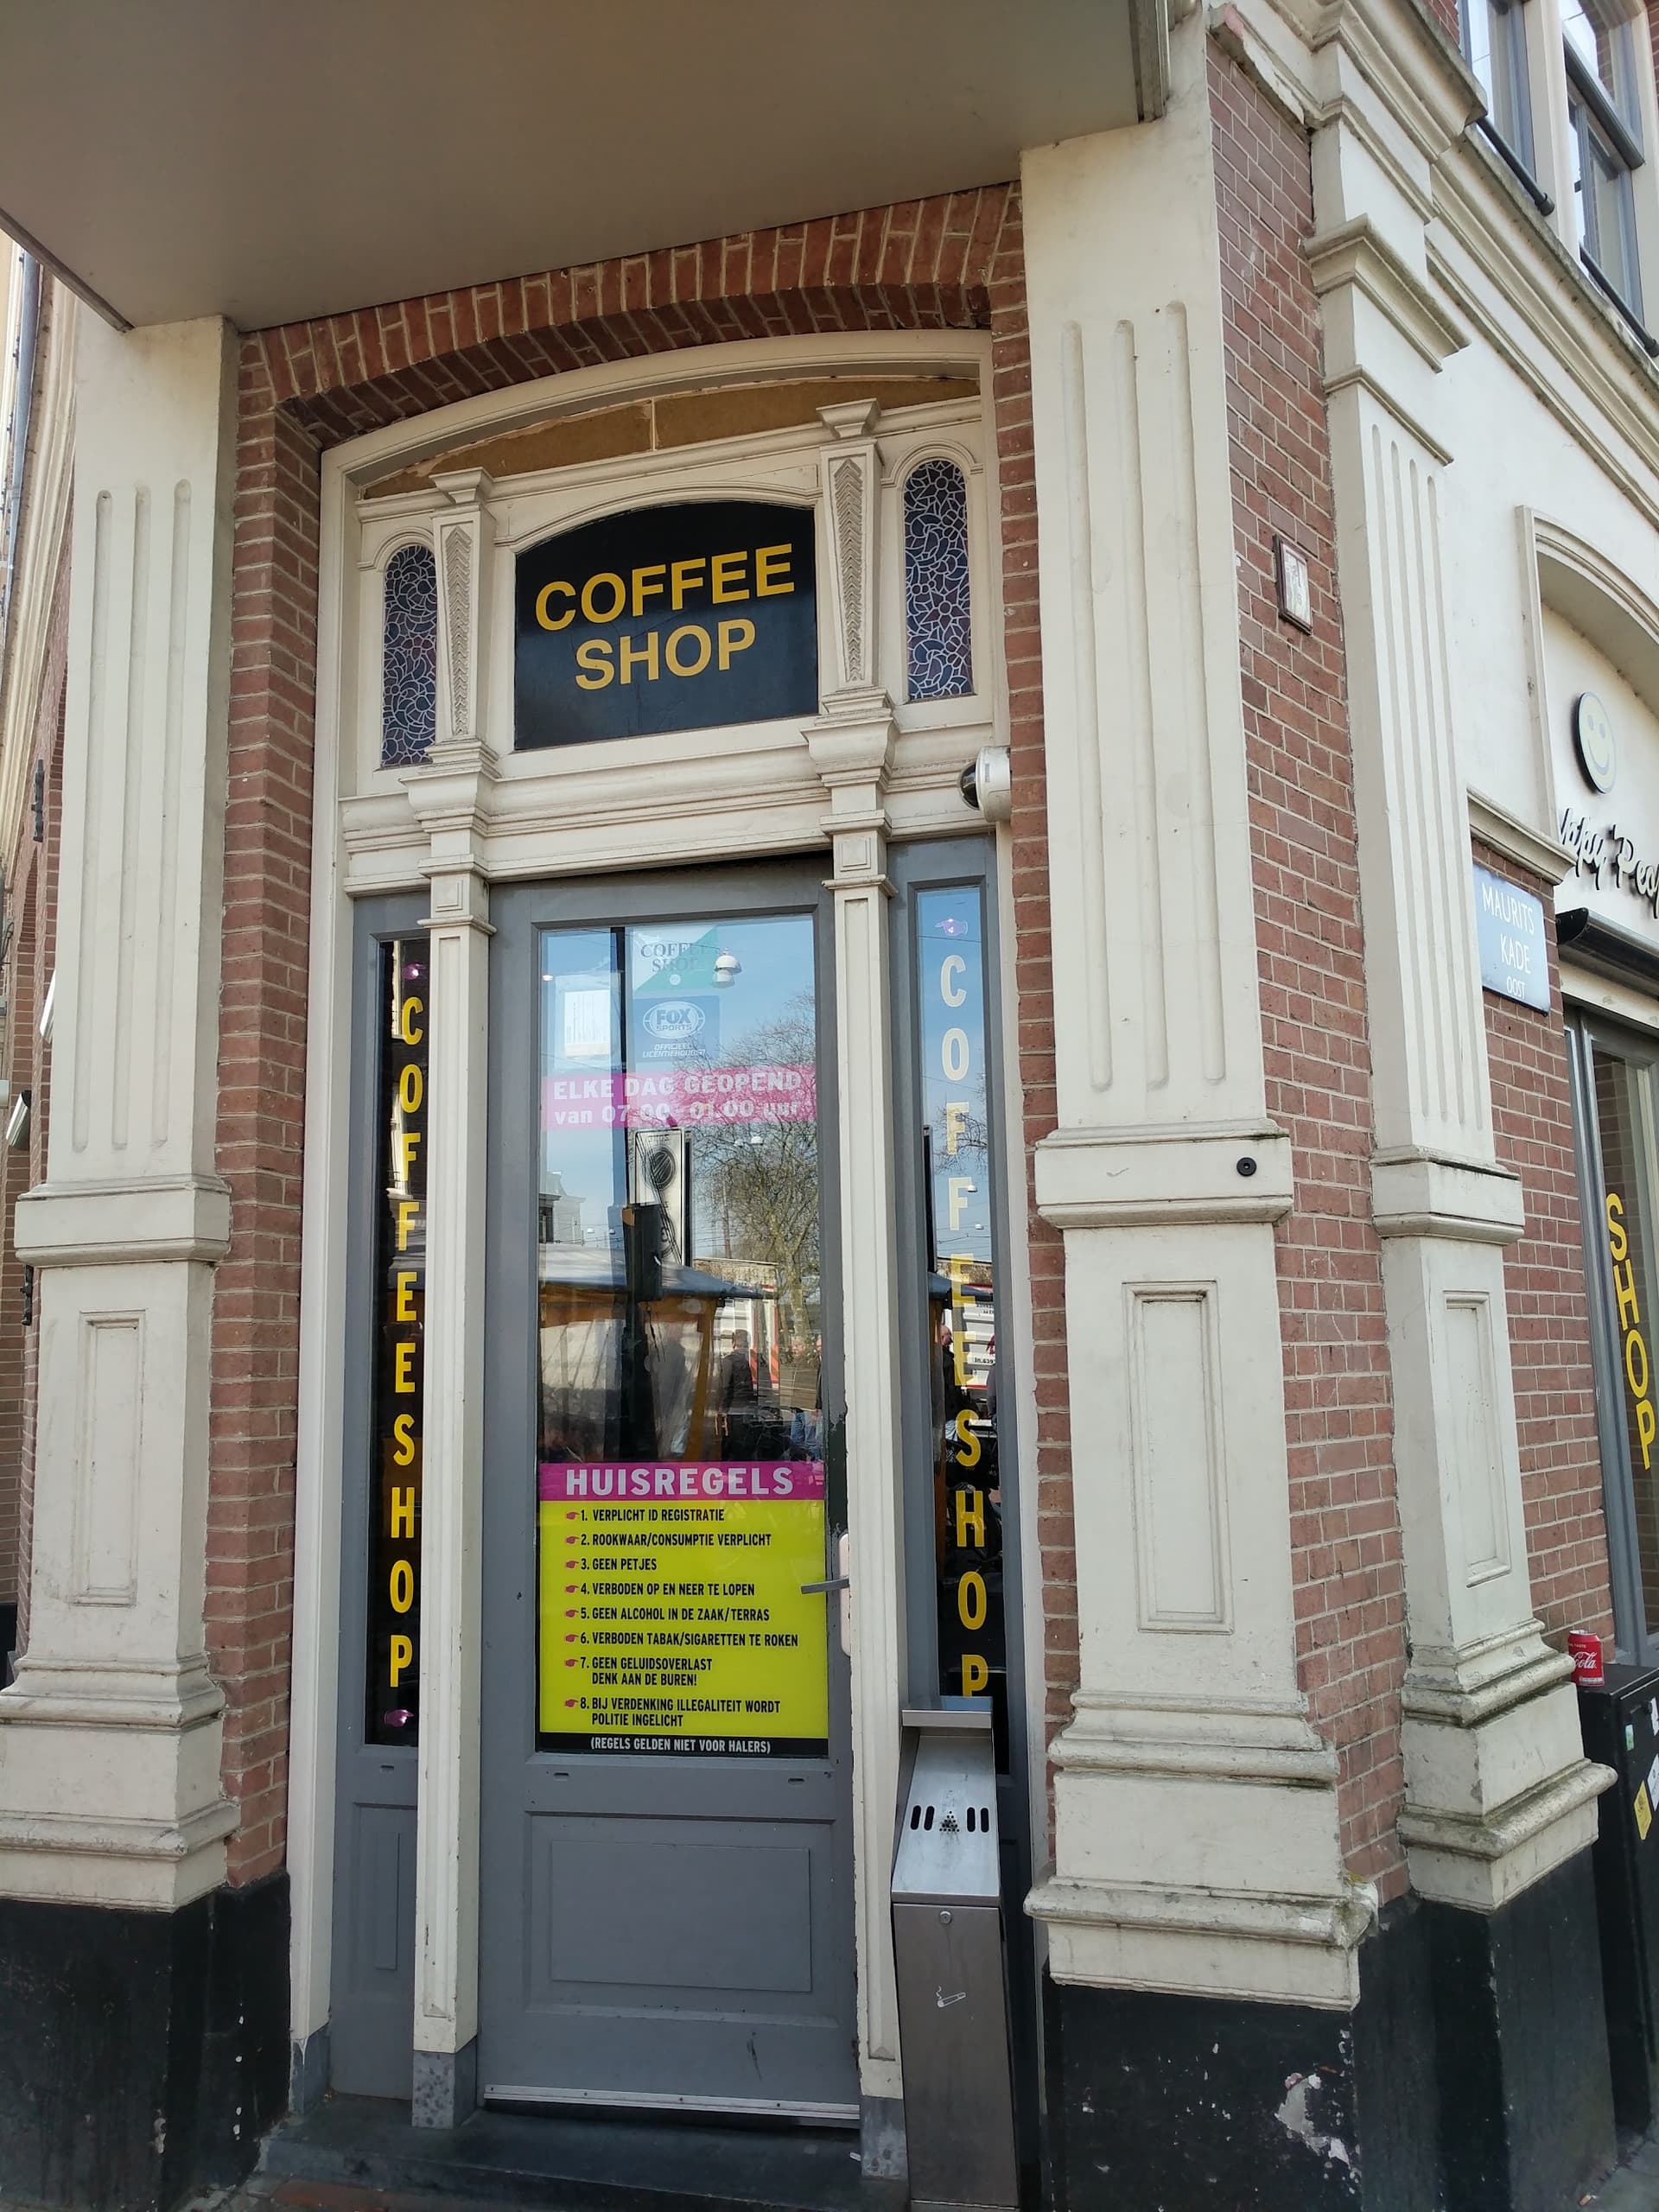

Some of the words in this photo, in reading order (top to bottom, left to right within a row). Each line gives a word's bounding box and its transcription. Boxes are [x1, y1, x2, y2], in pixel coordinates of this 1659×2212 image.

[535, 543, 795, 631] COFFEE
[575, 618, 756, 690] SHOP
[1481, 882, 1535, 935] MAURITS
[1500, 932, 1531, 975] KADE
[1506, 975, 1526, 1000] OOST
[656, 1008, 692, 1026] FOX
[553, 1079, 614, 1101] ELKE
[624, 1076, 676, 1097] DAG
[684, 1070, 802, 1095] GEOPEND
[554, 1108, 594, 1125] van
[1605, 1192, 1656, 1470] SHOP
[566, 1466, 794, 1497] HUISREGELS
[581, 1509, 588, 1522] 1.
[593, 1509, 645, 1522] VERPLICHT
[648, 1509, 658, 1522] ID
[661, 1509, 725, 1522] REGISTRATIE
[581, 1534, 590, 1546] 2.
[593, 1533, 715, 1547] ROOKWAAR/CONSUMPTIE
[717, 1534, 772, 1546] VERPLICHT
[581, 1558, 590, 1570] 3.
[592, 1558, 618, 1570] GEEN
[620, 1558, 657, 1571] PETJES
[580, 1582, 590, 1595] 4.
[592, 1582, 644, 1595] VERBODEN
[646, 1583, 660, 1595] OP
[663, 1583, 676, 1595] EN
[678, 1583, 704, 1596] NEER
[708, 1583, 720, 1596] TE
[722, 1583, 755, 1596] LOPEN
[580, 1607, 590, 1619] 5.
[592, 1607, 617, 1619] GEEN
[620, 1607, 665, 1620] ALCOHOL
[668, 1608, 678, 1620] IN
[681, 1608, 694, 1620] DE
[697, 1607, 770, 1621] ZAAK/TERRAS
[580, 1632, 590, 1644] 6.
[592, 1631, 644, 1644] VERBODEN
[647, 1631, 746, 1646] TABAK/SIGARETTEN
[748, 1633, 760, 1646] TE
[764, 1634, 798, 1646] ROKEN
[580, 1656, 589, 1669] 7.
[592, 1656, 617, 1669] GEEN
[620, 1657, 713, 1670] GELUIDSOVERLAST
[592, 1672, 618, 1684] DENK
[621, 1673, 642, 1685] AAN
[645, 1673, 658, 1685] DE
[661, 1674, 697, 1686] BUREN!
[580, 1697, 589, 1709] 8.
[592, 1697, 608, 1709] BIJ
[611, 1698, 674, 1711] VERDENKING
[677, 1699, 742, 1713] ILLEGALITEIT
[745, 1700, 781, 1713] WORDT
[592, 1713, 629, 1726] POLITIE
[632, 1713, 683, 1726] INGELICHT
[590, 1737, 631, 1750] (REGELS
[633, 1738, 671, 1751] GELDEN
[673, 1738, 696, 1751] NIET
[698, 1739, 726, 1752] VOOR
[728, 1740, 771, 1754] HALERS)
